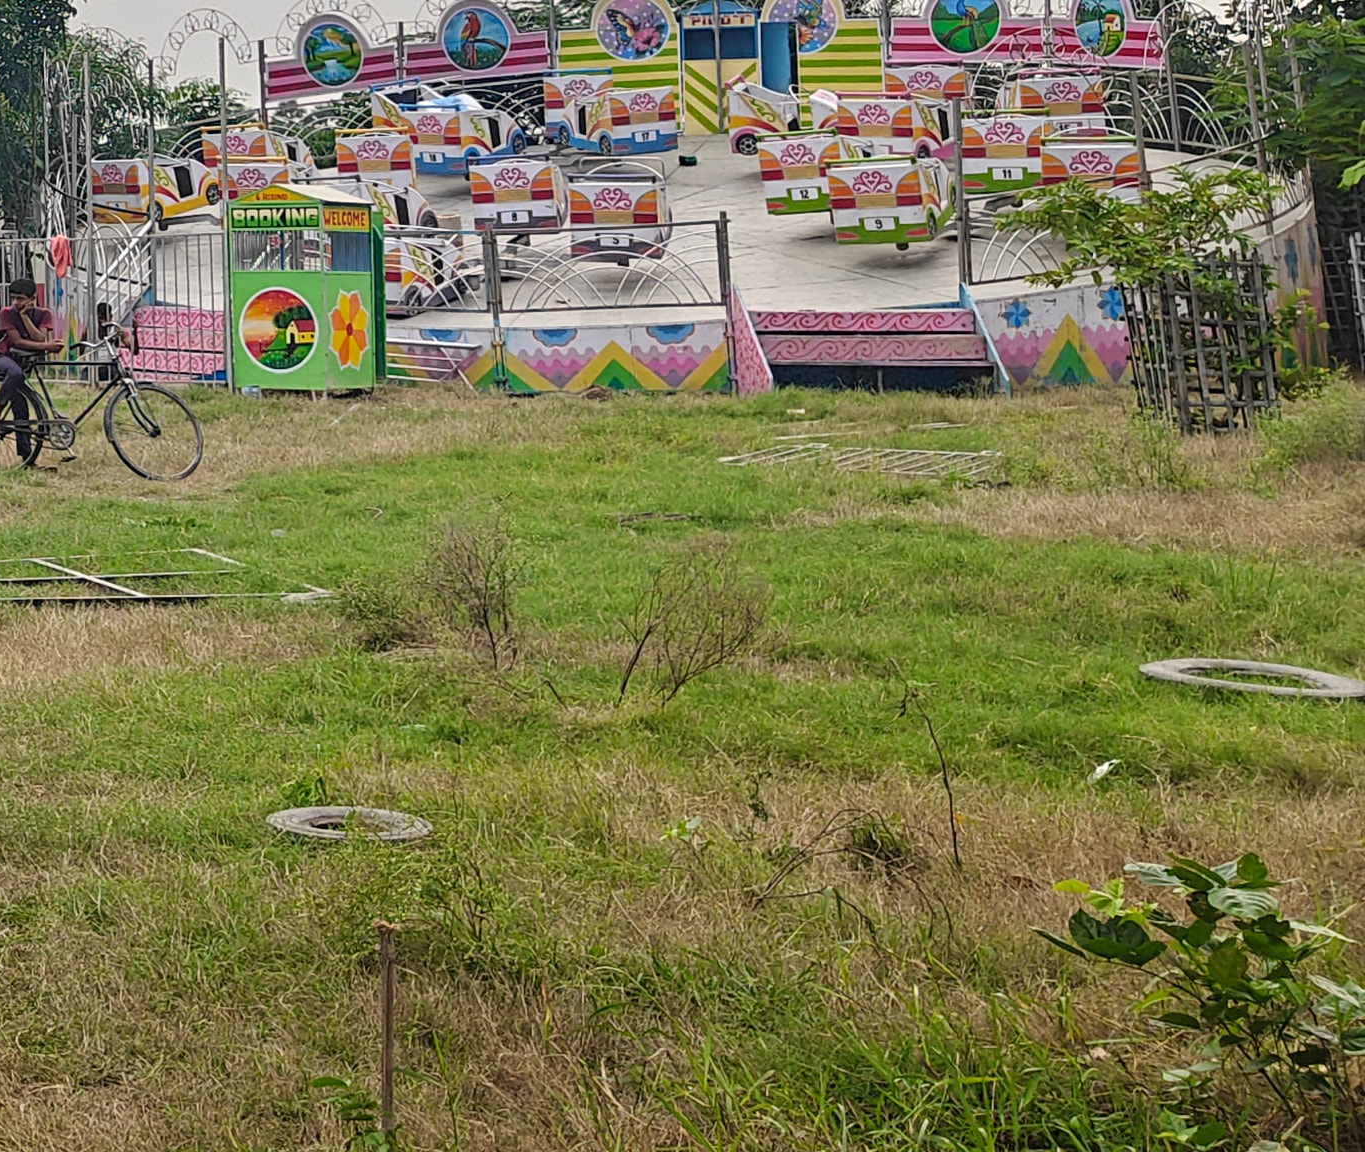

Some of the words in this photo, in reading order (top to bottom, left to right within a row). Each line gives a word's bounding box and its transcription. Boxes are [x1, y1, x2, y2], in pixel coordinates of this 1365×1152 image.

[642, 132, 649, 141] 17
[1002, 169, 1012, 179] 11
[800, 189, 809, 199] 12
[232, 208, 319, 228] BOOKING
[324, 210, 366, 227] WELCOME
[875, 219, 883, 230] 9
